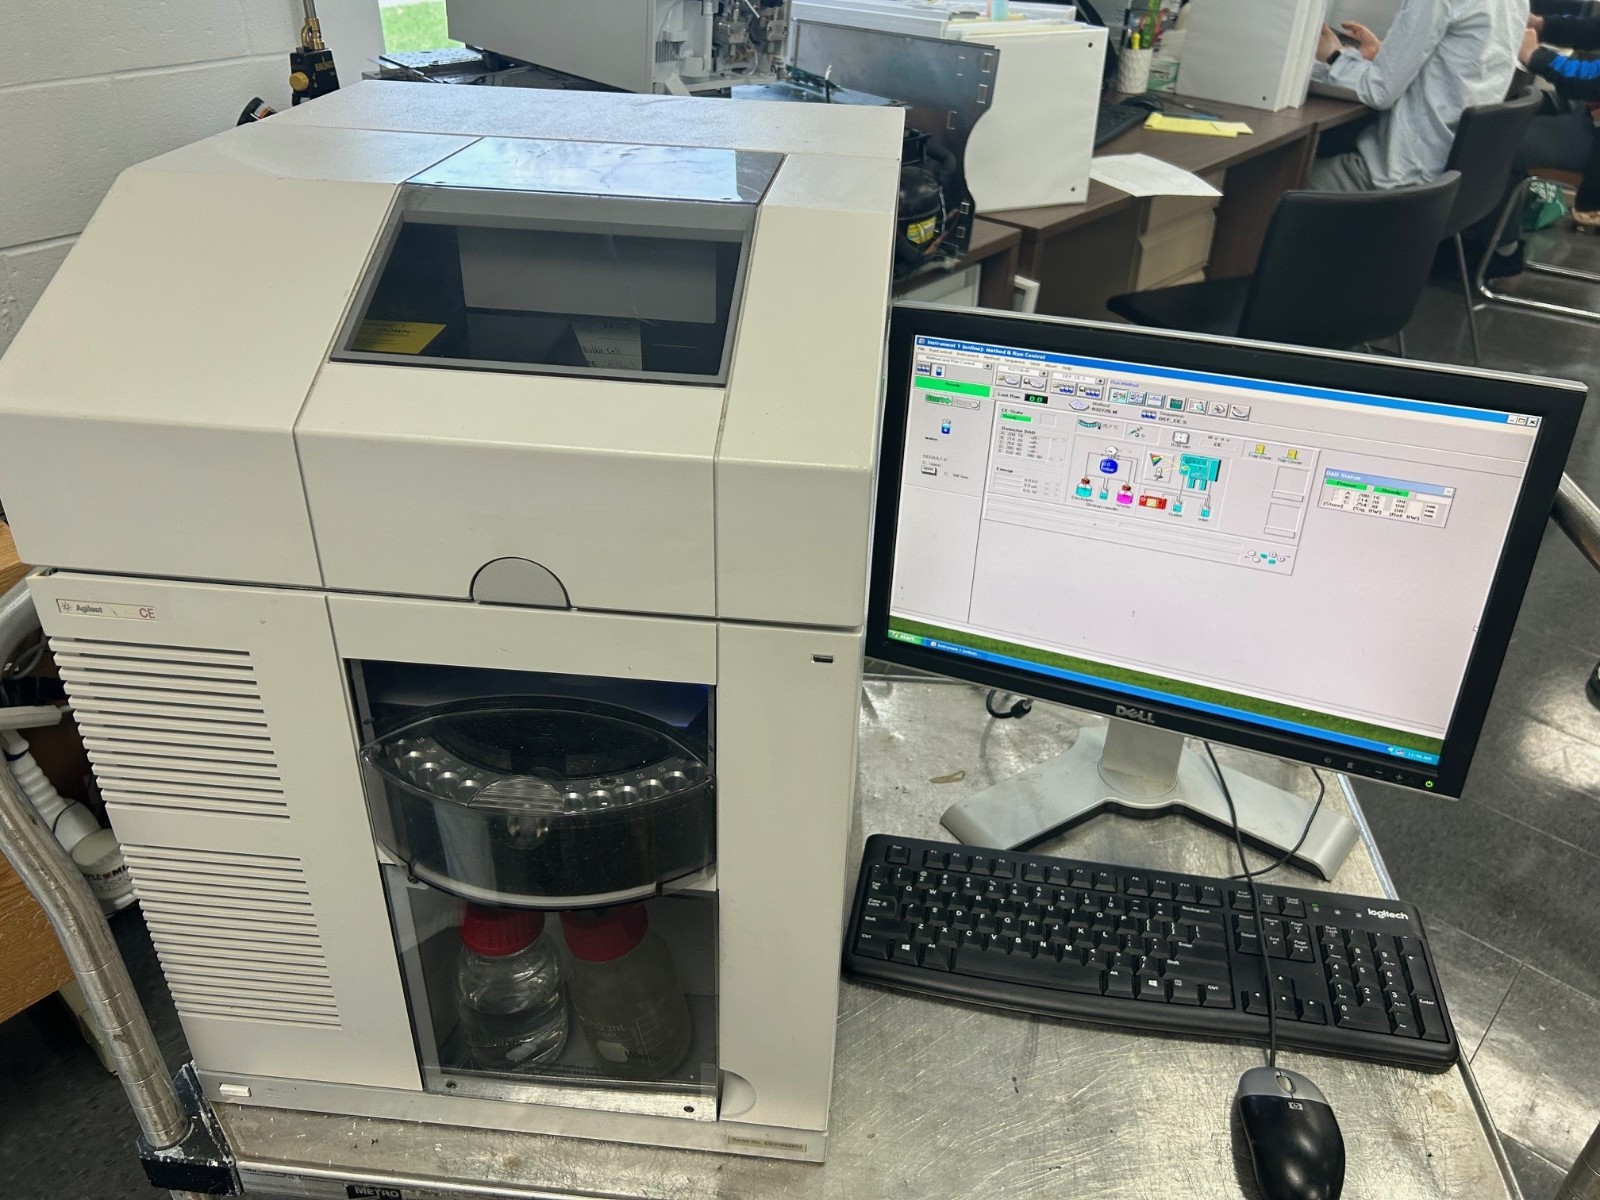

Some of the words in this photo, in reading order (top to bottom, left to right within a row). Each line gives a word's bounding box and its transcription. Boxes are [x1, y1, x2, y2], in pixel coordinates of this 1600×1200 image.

[927, 340, 956, 348] Instrument
[1024, 352, 1046, 360] Control
[76, 604, 103, 614] Agilent
[139, 607, 156, 619] CE
[1114, 704, 1155, 724] DELL
[1182, 905, 1210, 914] Backspace
[1367, 908, 1409, 920] logitech
[353, 1185, 399, 1199] METRO
